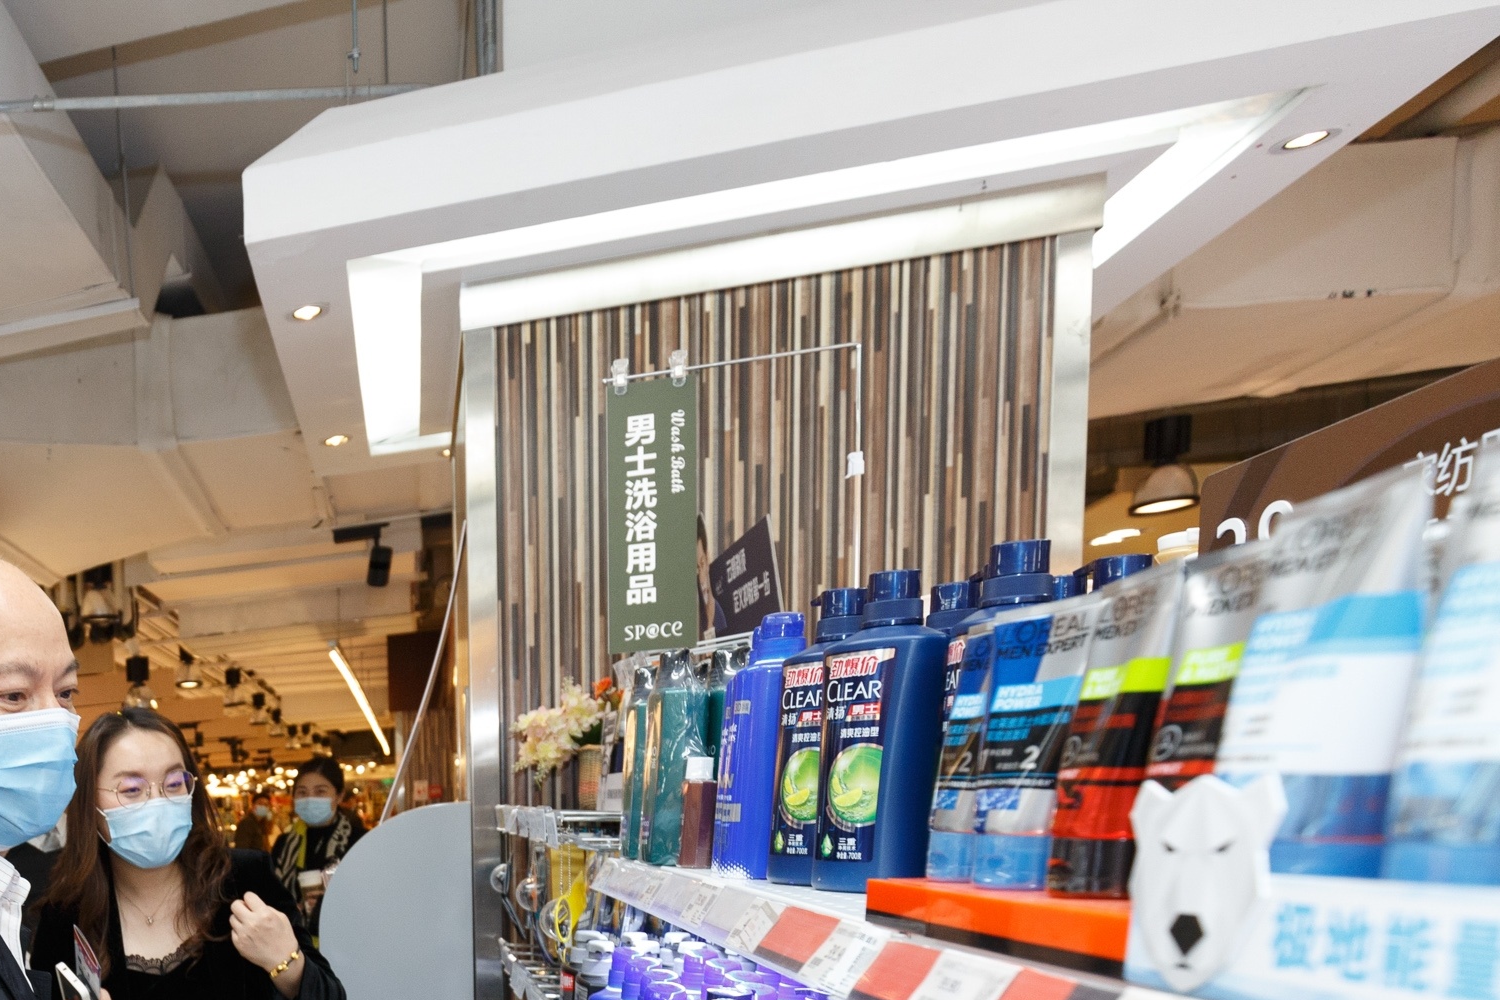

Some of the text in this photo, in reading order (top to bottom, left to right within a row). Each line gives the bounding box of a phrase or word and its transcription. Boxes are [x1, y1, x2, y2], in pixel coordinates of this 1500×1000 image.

[671, 409, 686, 494] Wash Bath
[624, 412, 658, 606] 男士洗浴用品
[997, 633, 1089, 660] MEN EXPERT
[830, 656, 879, 680] 劲爆价
[827, 680, 882, 703] CLEAR
[999, 684, 1043, 699] HYDRA
[827, 703, 879, 721] 清扬 男士
[995, 696, 1042, 711] POWER
[840, 726, 879, 739] 清爽控油型
[958, 751, 972, 773] 2
[1020, 745, 1040, 770] 2
